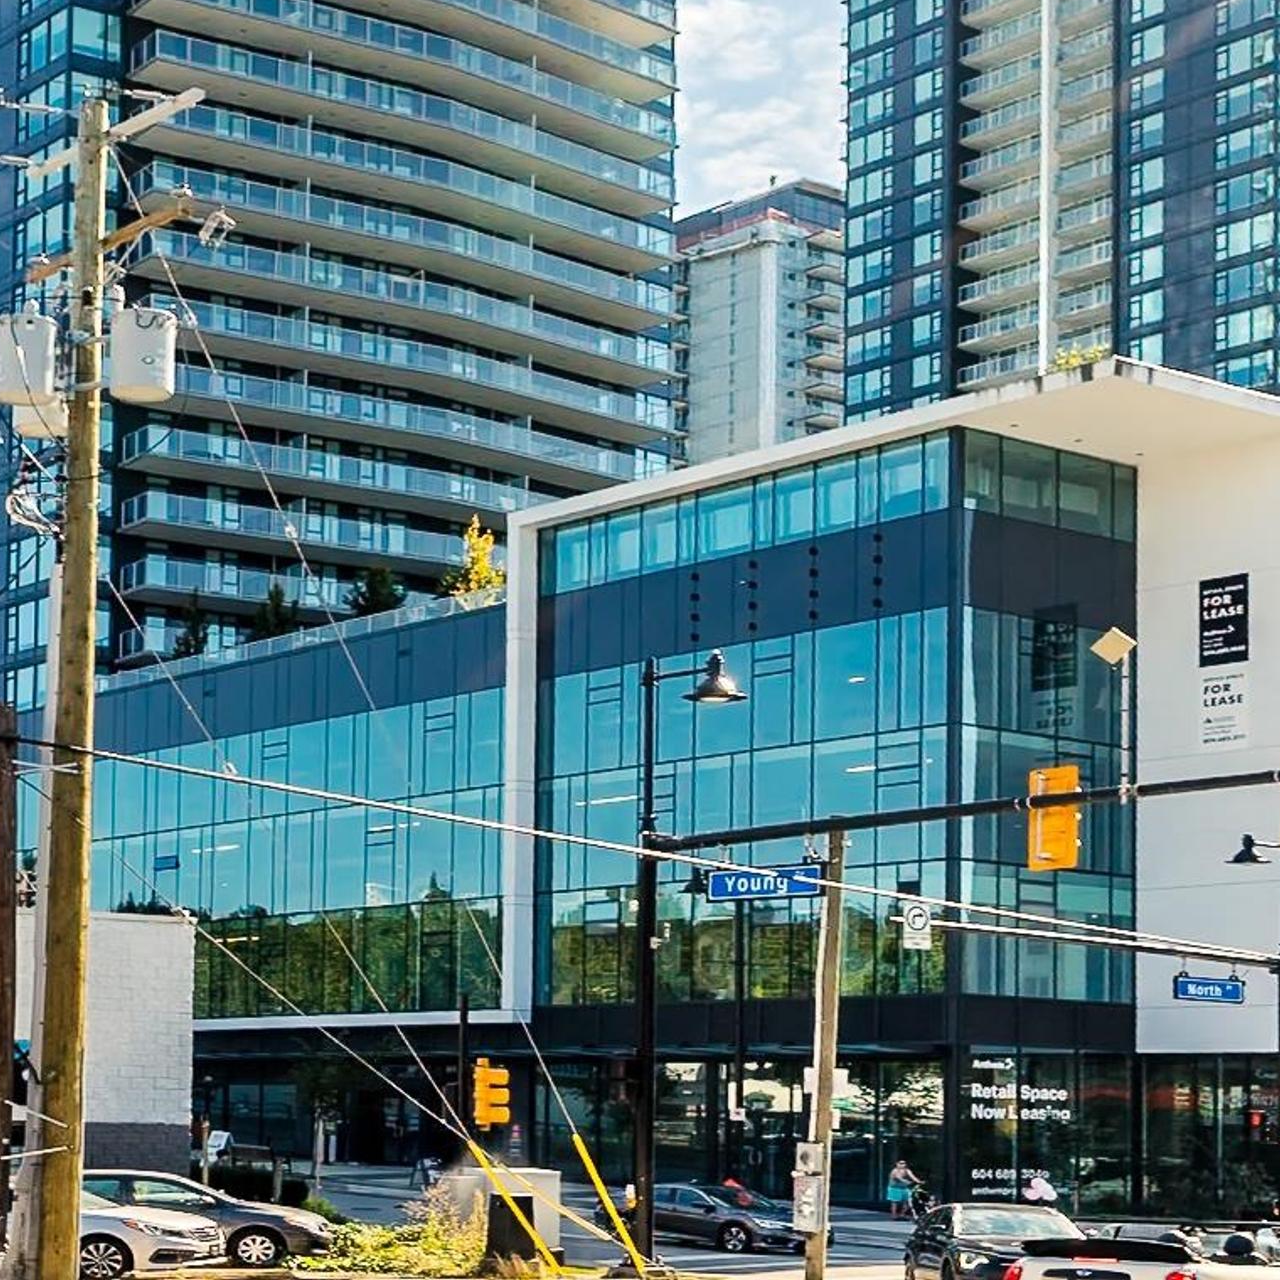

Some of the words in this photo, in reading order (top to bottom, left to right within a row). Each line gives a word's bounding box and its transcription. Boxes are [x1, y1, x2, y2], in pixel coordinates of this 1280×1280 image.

[1203, 595, 1232, 608] FOR
[1203, 604, 1244, 620] LEASE
[1203, 684, 1232, 695] FOR
[1203, 694, 1244, 708] LEASE
[724, 876, 788, 895] Young
[1187, 984, 1222, 996] North
[971, 1083, 1017, 1099] Retail
[1021, 1085, 1069, 1102] Space
[971, 1103, 1006, 1120] Now
